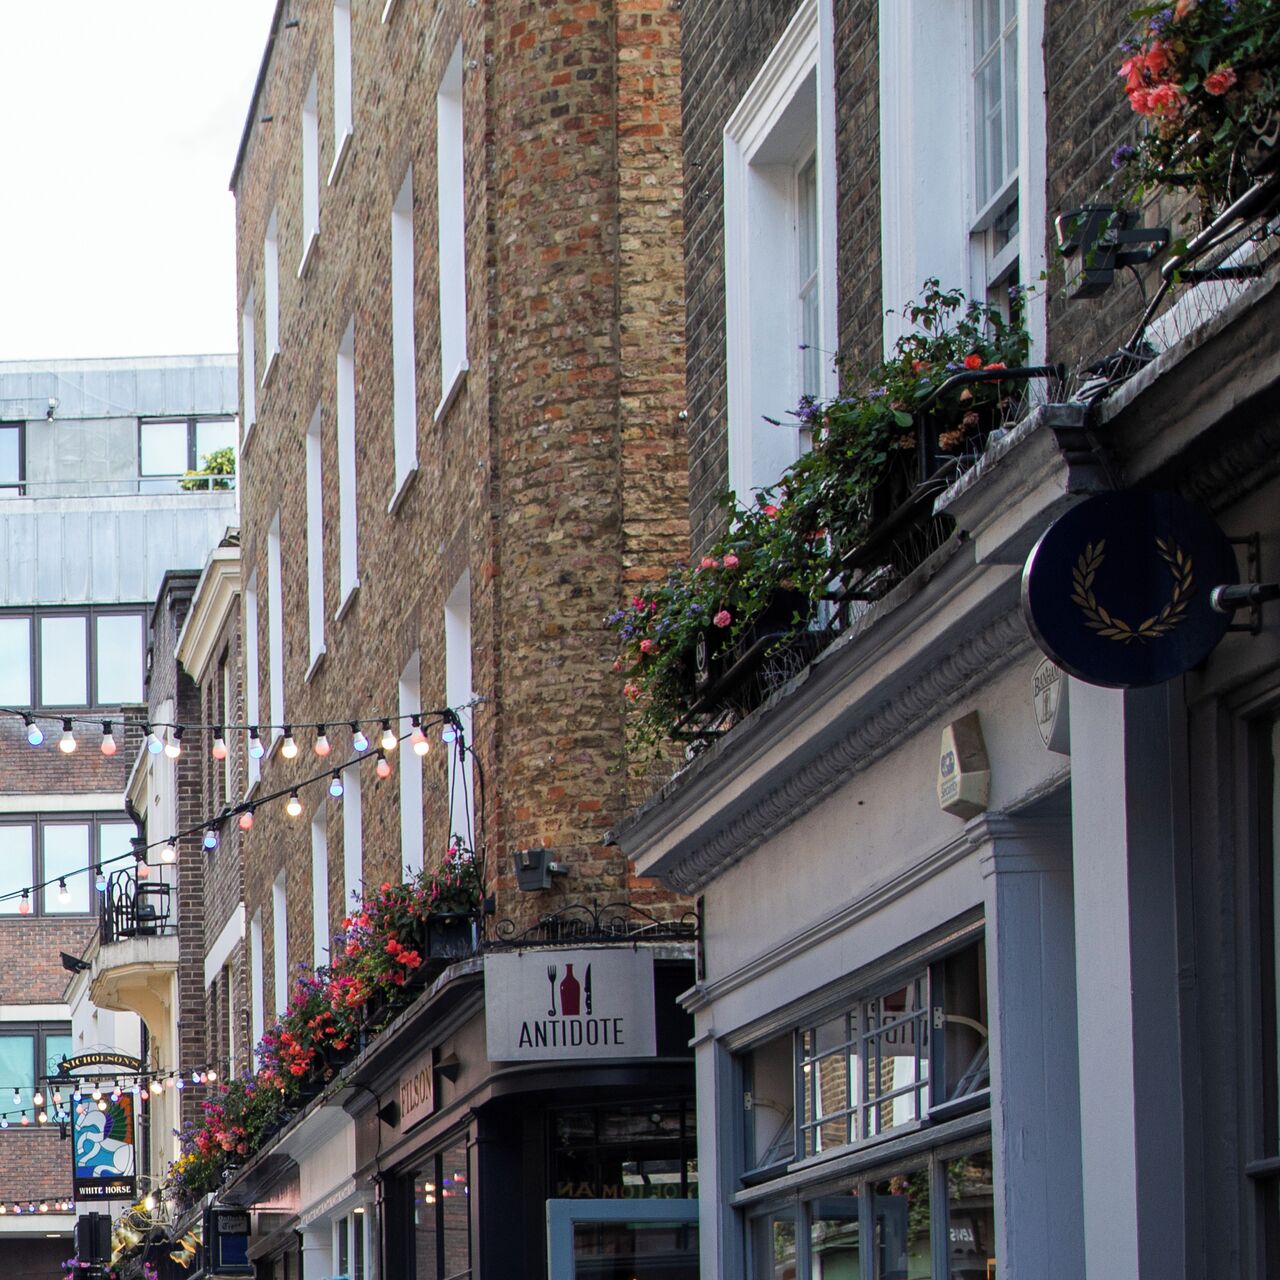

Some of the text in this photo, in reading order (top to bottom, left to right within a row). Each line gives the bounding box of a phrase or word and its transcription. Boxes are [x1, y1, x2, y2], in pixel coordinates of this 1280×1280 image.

[519, 1018, 624, 1048] ANTIDOTE
[62, 1055, 139, 1070] NICHOLSON'S
[400, 1064, 432, 1118] FILSON
[79, 1185, 131, 1195] WHITE HORSE
